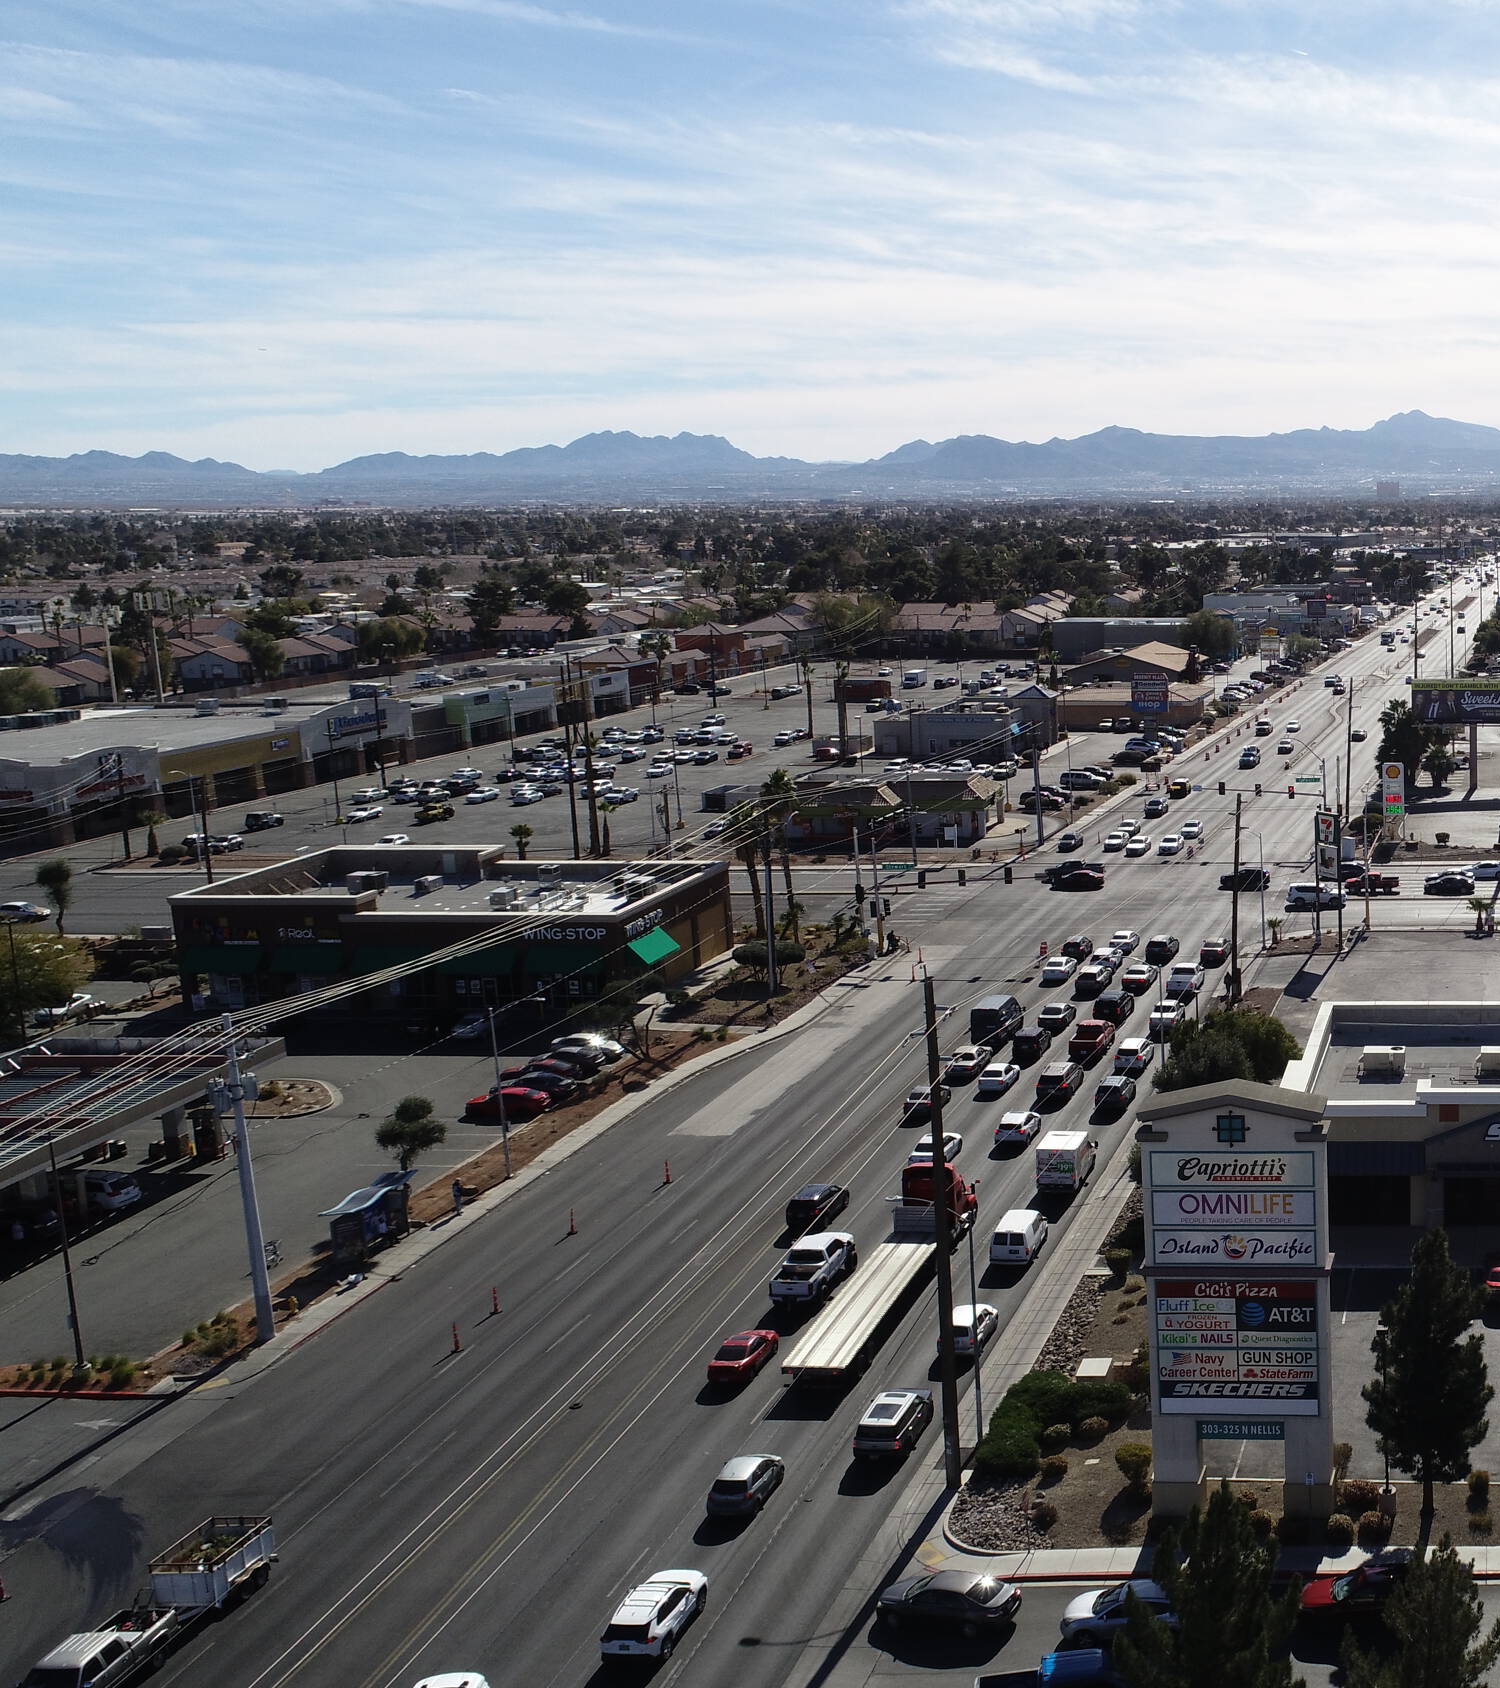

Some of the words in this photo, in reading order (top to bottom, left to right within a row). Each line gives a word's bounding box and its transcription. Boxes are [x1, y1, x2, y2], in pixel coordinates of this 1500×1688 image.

[1461, 690, 1493, 704] Sweet
[1177, 1157, 1286, 1182] Capriotti's
[1178, 1194, 1294, 1214] OMNILIFE
[1158, 1238, 1219, 1255] Island
[1246, 1238, 1312, 1259] Pacific
[1158, 1299, 1190, 1312] Fluff
[1192, 1299, 1216, 1312] Ice
[1268, 1307, 1314, 1323] AT&T
[1176, 1320, 1230, 1329] YOGURT
[1200, 1334, 1234, 1344] NAILS
[1250, 1335, 1272, 1343] Quest
[1273, 1335, 1313, 1344] Diagnostics
[1195, 1353, 1224, 1366] Navy
[1242, 1352, 1272, 1364] GUN
[1275, 1352, 1313, 1364] SHOP
[1160, 1366, 1198, 1378] Career
[1199, 1366, 1237, 1378] Center
[1173, 1383, 1307, 1397] SKECHERS
[1202, 1424, 1240, 1434] 303-325
[1241, 1424, 1249, 1434] N
[1250, 1425, 1281, 1436] NELLIS
